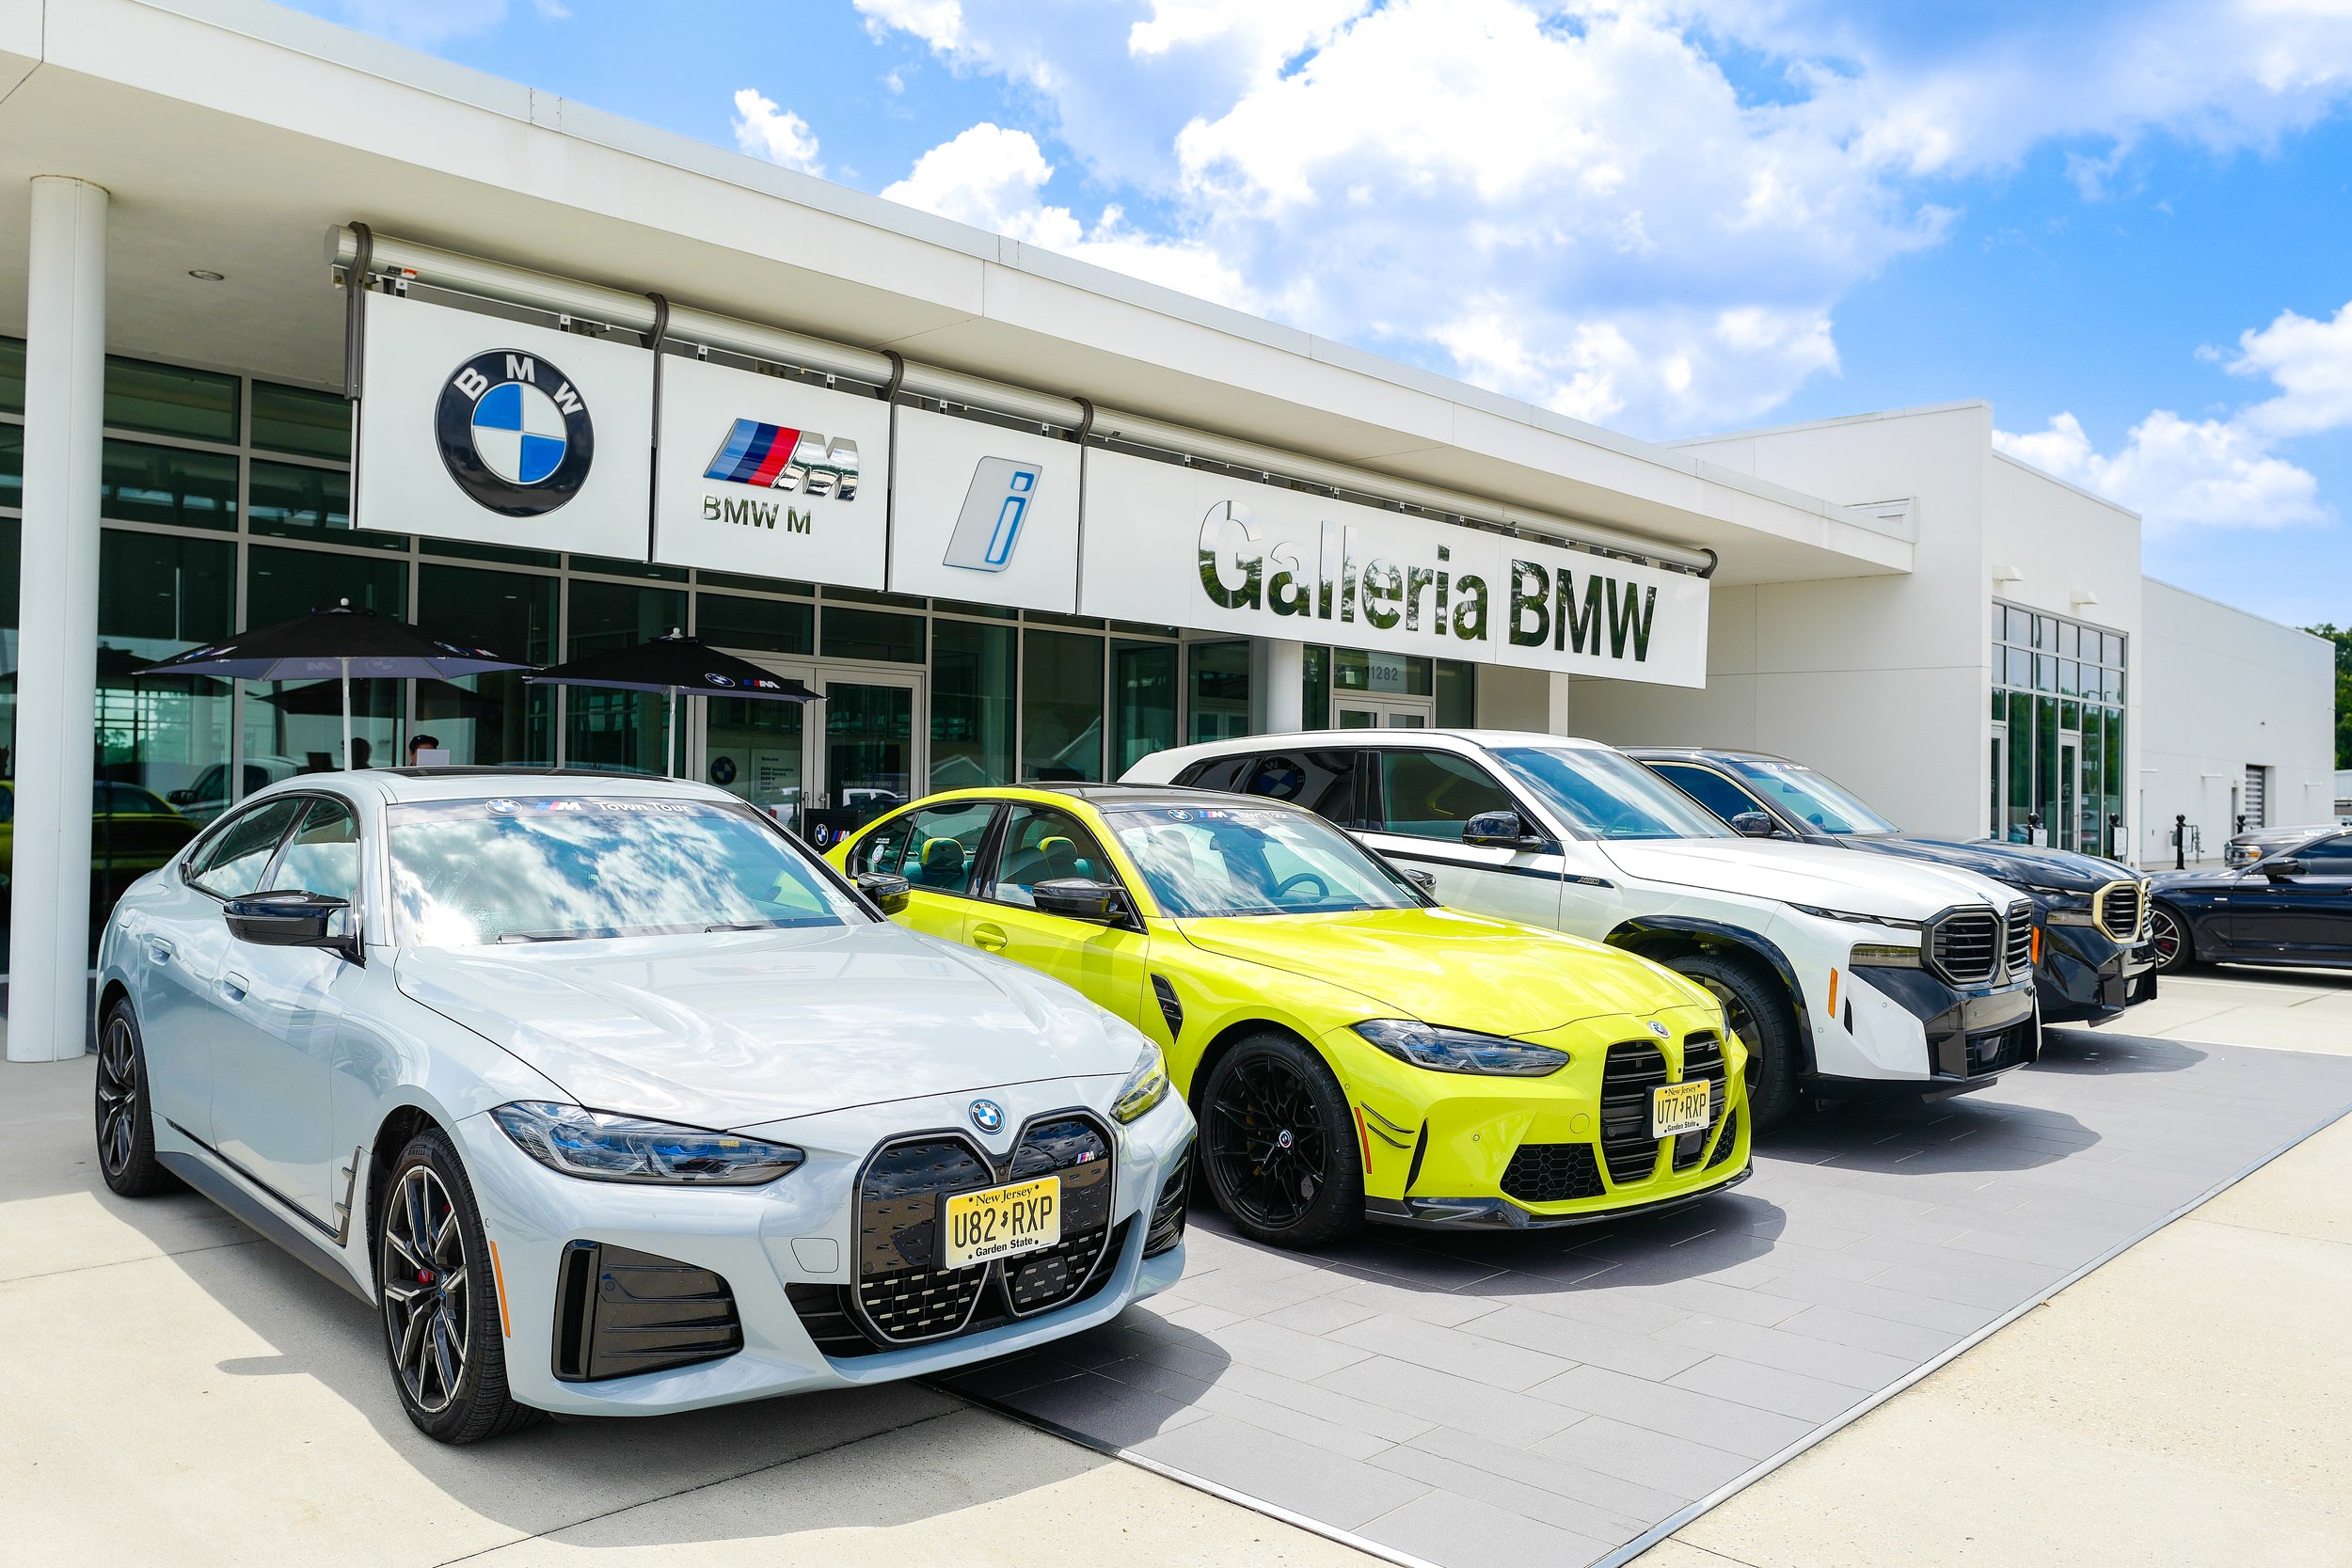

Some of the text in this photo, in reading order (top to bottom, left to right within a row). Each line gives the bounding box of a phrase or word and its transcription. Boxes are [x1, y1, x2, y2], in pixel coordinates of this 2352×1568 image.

[453, 354, 584, 416] BMW
[701, 492, 812, 535] BMW M
[984, 470, 1034, 565] i
[1198, 499, 1658, 662] Galleria BMW
[592, 801, 652, 812] Town
[649, 801, 690, 813] Tour
[1680, 1085, 1696, 1096] Jersey
[1658, 1093, 1707, 1124] U77 RXP
[1667, 1123, 1684, 1132] Garden
[1684, 1120, 1696, 1129] State
[976, 1187, 1033, 1207] New Jersey
[954, 1196, 1053, 1248] U82 RXP
[976, 1236, 1033, 1258] Garden State
